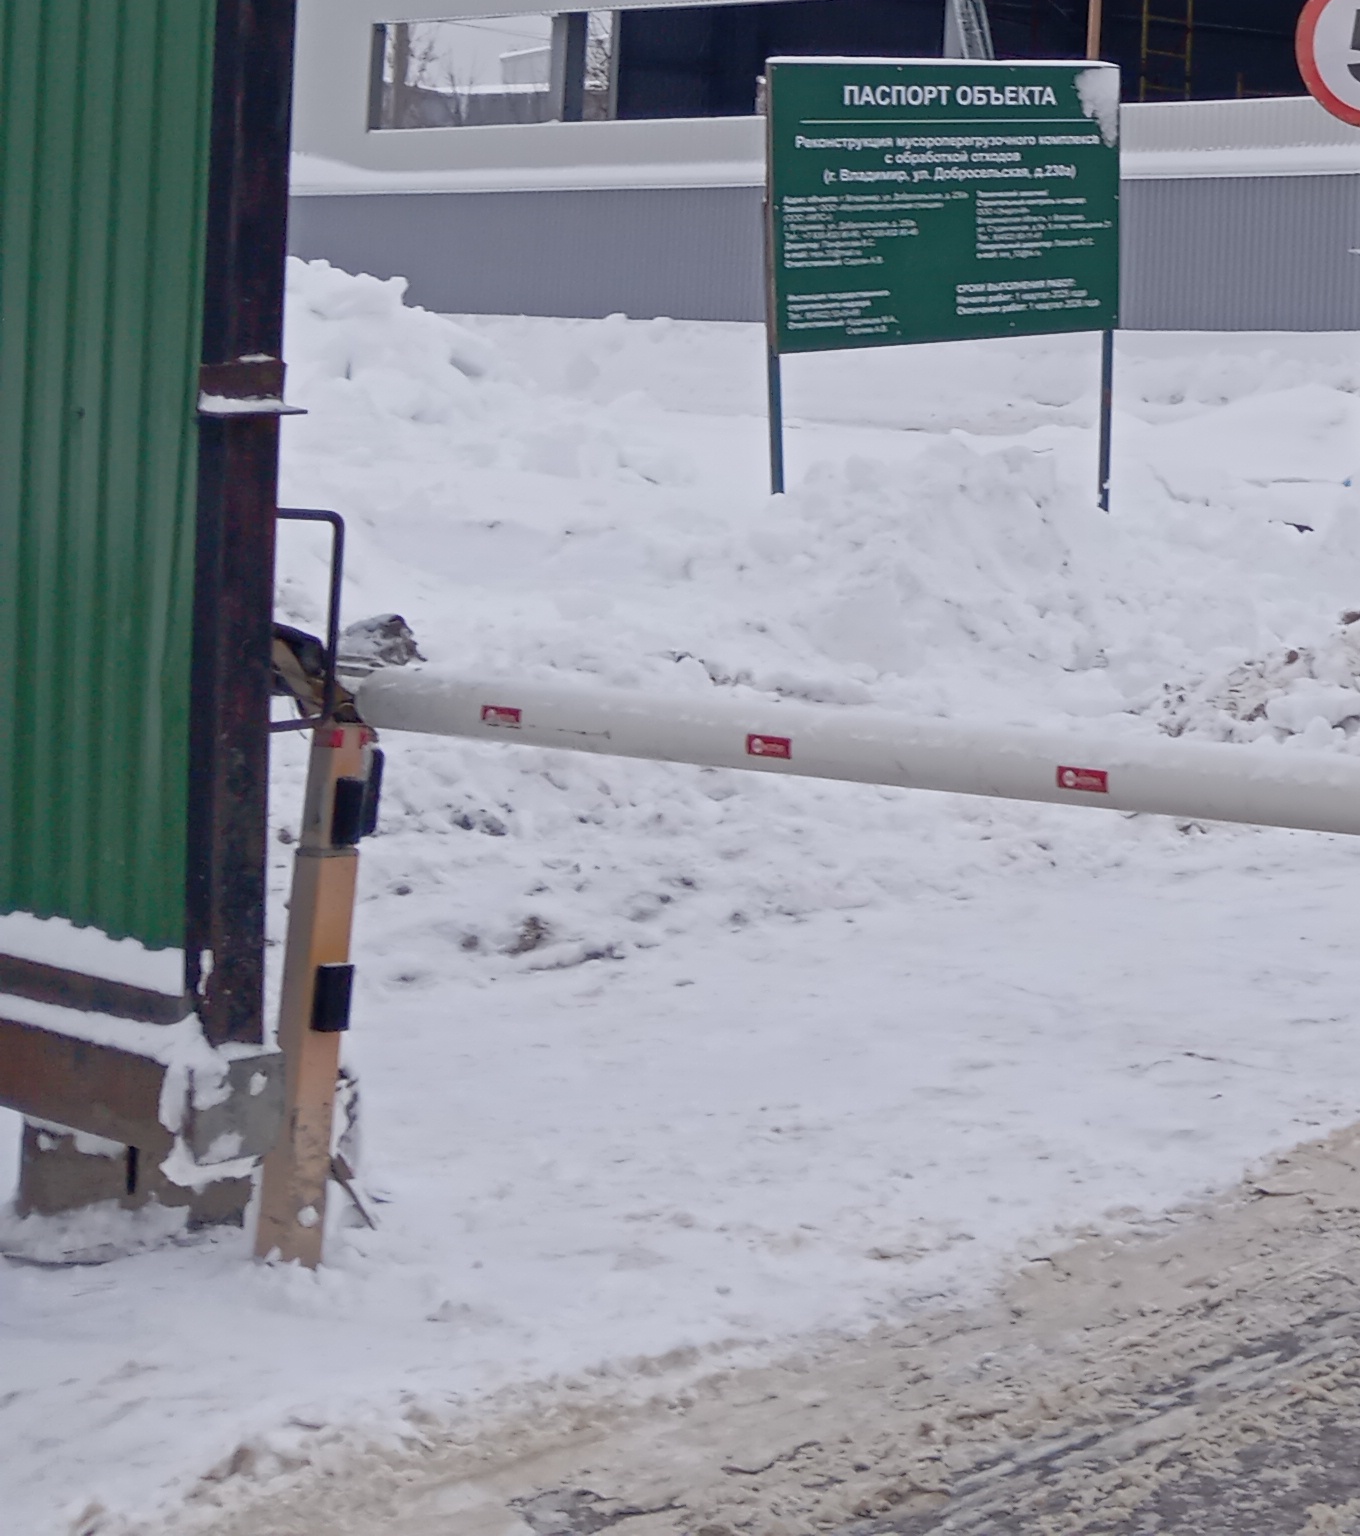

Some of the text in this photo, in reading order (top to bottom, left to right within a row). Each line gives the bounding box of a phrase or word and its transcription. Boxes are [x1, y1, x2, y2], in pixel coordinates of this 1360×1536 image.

[843, 85, 1058, 106] ПАСПОРТ ОБЪЕКТА
[884, 150, 1021, 166] с обработкой отходов
